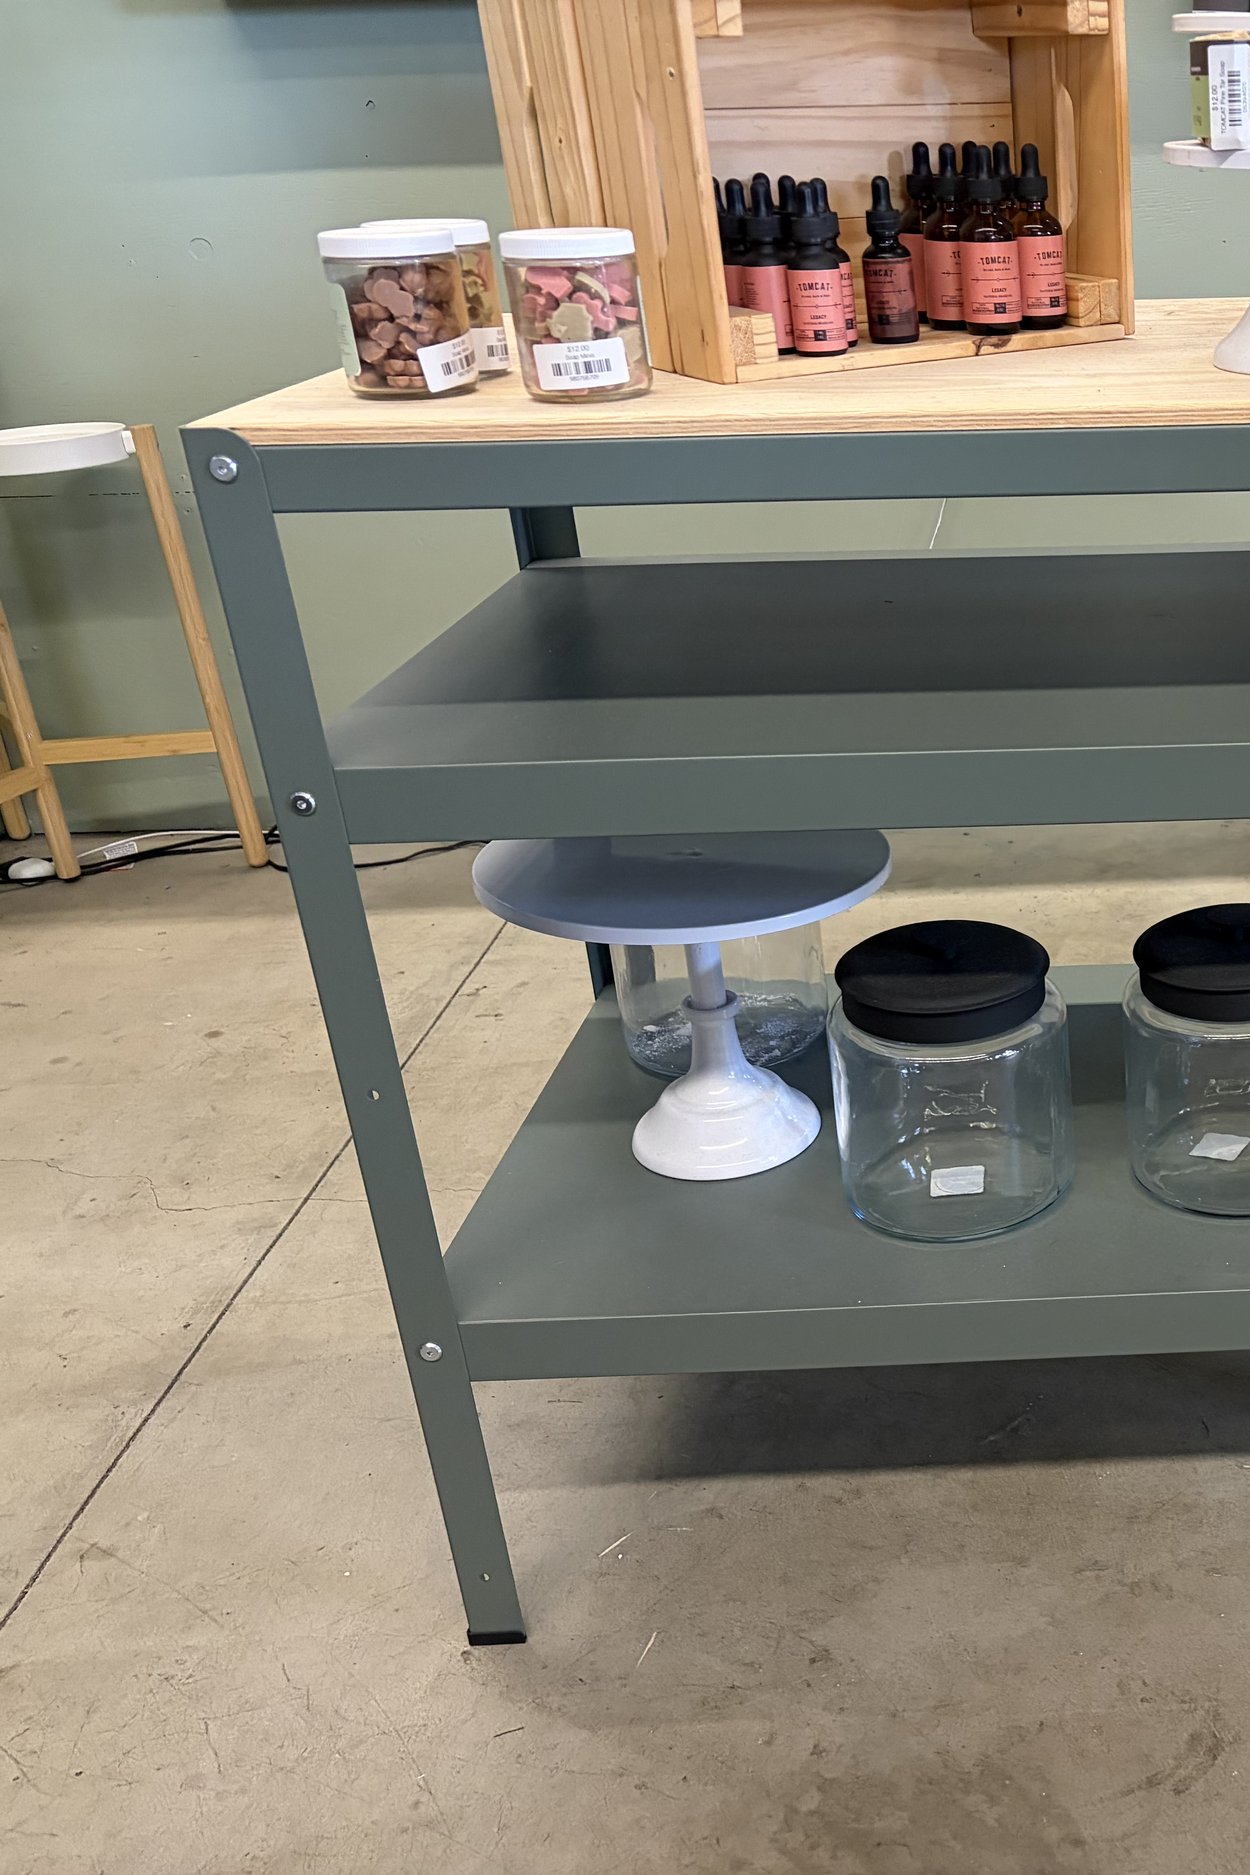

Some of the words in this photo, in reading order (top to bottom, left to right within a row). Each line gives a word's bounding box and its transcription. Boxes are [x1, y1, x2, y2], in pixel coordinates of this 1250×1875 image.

[1211, 84, 1219, 111] $12.00
[980, 255, 1011, 266] TOMCAT
[798, 281, 831, 292] TOMCAT
